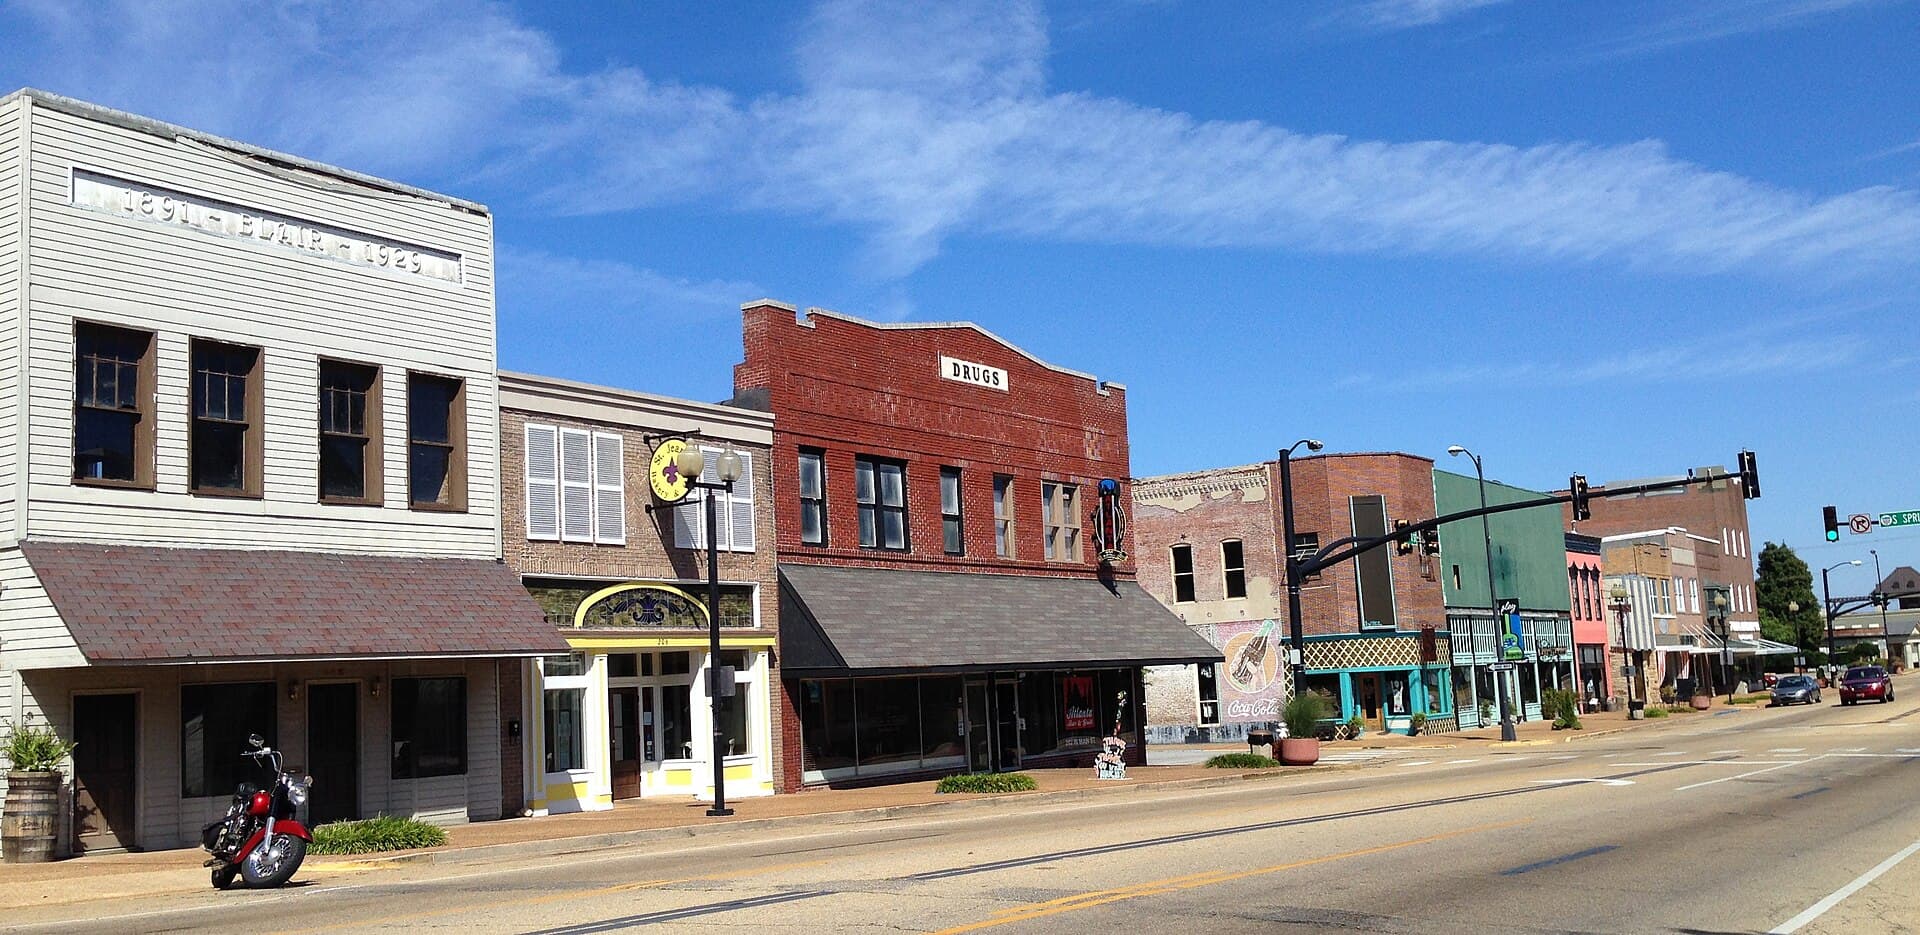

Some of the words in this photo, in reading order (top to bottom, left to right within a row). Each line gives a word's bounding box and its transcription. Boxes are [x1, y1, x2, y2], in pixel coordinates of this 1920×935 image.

[124, 188, 189, 224] 1891
[239, 212, 324, 251] BLAIR
[364, 241, 422, 273] 1929
[952, 362, 1000, 386] DRUGS
[653, 454, 665, 466] St.
[1892, 514, 1898, 525] S
